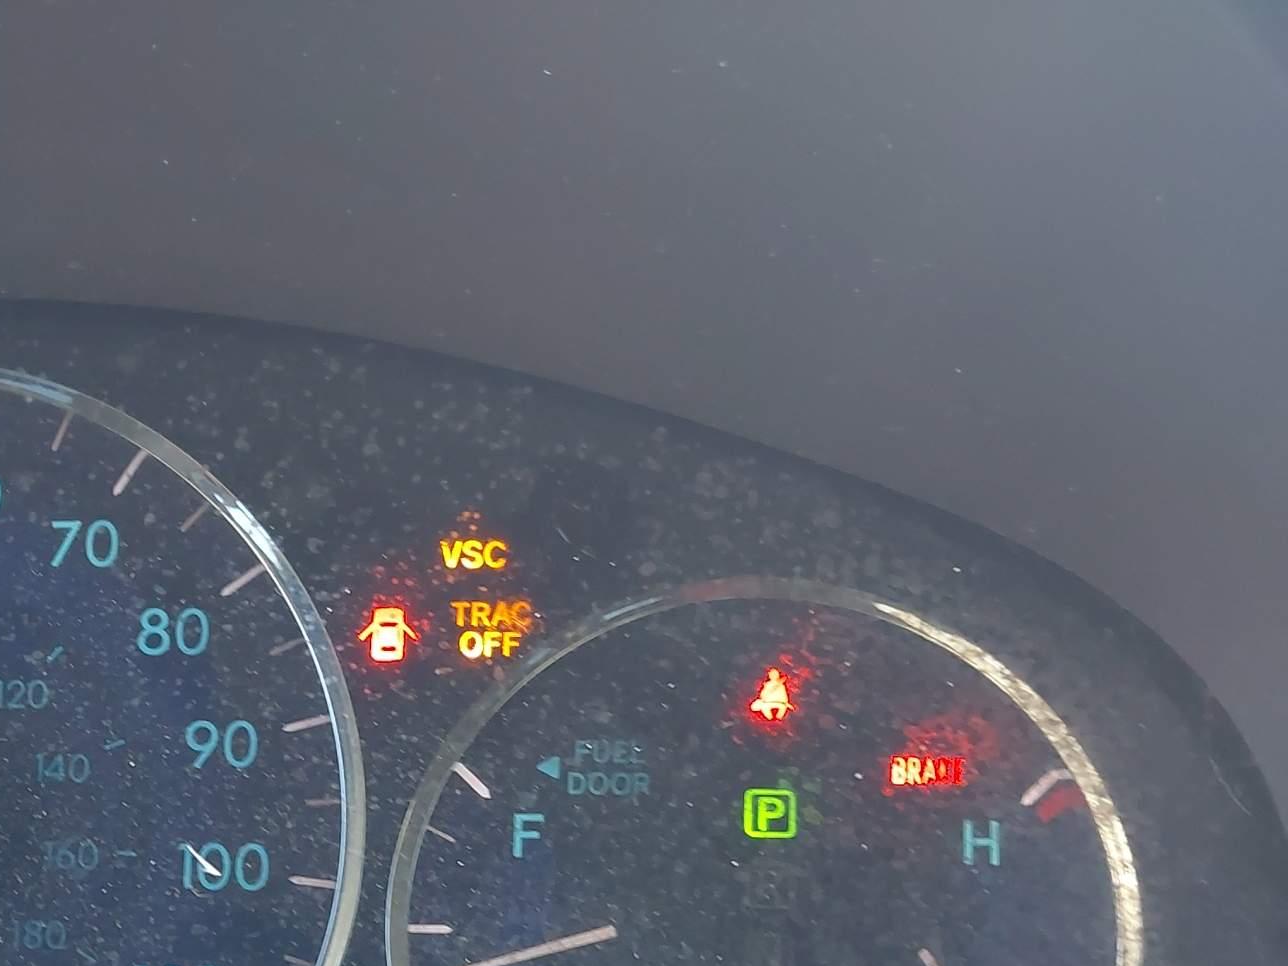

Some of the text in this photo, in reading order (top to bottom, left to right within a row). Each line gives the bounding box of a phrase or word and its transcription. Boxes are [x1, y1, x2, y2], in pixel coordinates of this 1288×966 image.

[50, 519, 119, 567] 70
[440, 540, 507, 569] VSC
[451, 600, 532, 629] TRAC
[137, 607, 209, 656] 80
[459, 631, 522, 659] OFF
[185, 720, 258, 769] 90
[37, 753, 90, 783] 140
[567, 772, 649, 796] DOOR
[756, 799, 785, 831] P
[513, 813, 544, 858] F
[963, 820, 1000, 865] H
[47, 838, 99, 870] 160
[181, 842, 269, 891] 100
